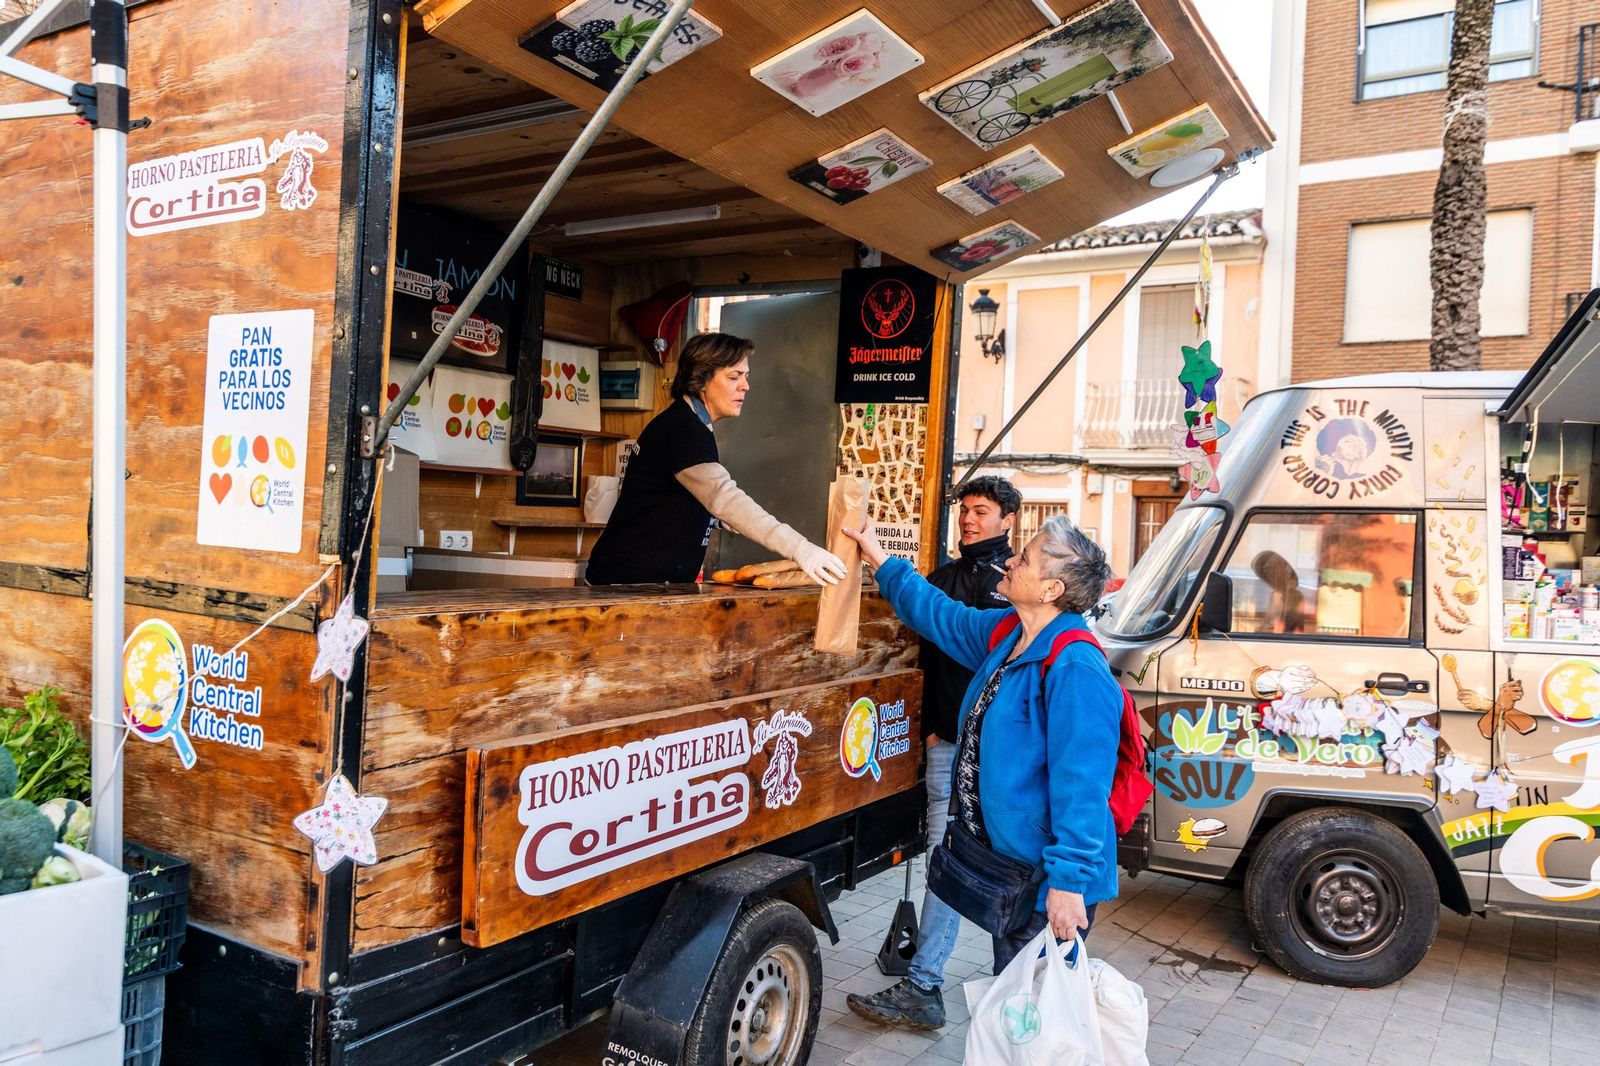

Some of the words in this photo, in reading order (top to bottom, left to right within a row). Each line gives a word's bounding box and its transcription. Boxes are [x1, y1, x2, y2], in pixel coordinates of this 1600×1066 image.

[131, 161, 176, 189] HORNO
[178, 144, 262, 180] PASTELERIA
[130, 184, 261, 229] Cortina
[398, 269, 432, 286] PASTELERIA
[546, 264, 558, 284] NG
[560, 268, 581, 289] NECK
[433, 311, 454, 323] HORN
[241, 325, 272, 346] PAN
[229, 347, 283, 368] GRATIS
[849, 345, 922, 365] Jägermeister
[218, 369, 258, 389] PARA
[262, 368, 292, 389] LOS
[853, 373, 878, 382] DRINK
[879, 373, 892, 382] ICE
[893, 372, 916, 382] COLD
[222, 390, 286, 411] VECINOS
[1333, 398, 1370, 418] THE
[1305, 405, 1327, 422] IS
[1280, 419, 1311, 450] THIS
[1373, 409, 1414, 462] MIGHTY
[273, 480, 290, 488] World
[273, 488, 294, 498] Central
[1349, 464, 1403, 500] FUNKY
[273, 498, 295, 507] Kitchen
[875, 527, 901, 538] HIBIDA
[903, 528, 913, 539] LA
[888, 540, 919, 552] BEBIDAS
[193, 645, 247, 679] World
[192, 678, 261, 715] Central
[880, 699, 905, 722] World
[191, 709, 262, 749] Kitchen
[755, 723, 768, 750] La
[879, 716, 910, 742] Central
[878, 738, 910, 760] Kitchen
[1236, 729, 1279, 759] de
[1291, 733, 1375, 765] Vero
[527, 757, 620, 812] HORNO
[626, 728, 746, 785] PASTELERIA
[1156, 761, 1248, 803] SOUL
[1516, 784, 1550, 807] TIN
[524, 782, 744, 882] Cortina
[1452, 814, 1505, 842] JAZZ
